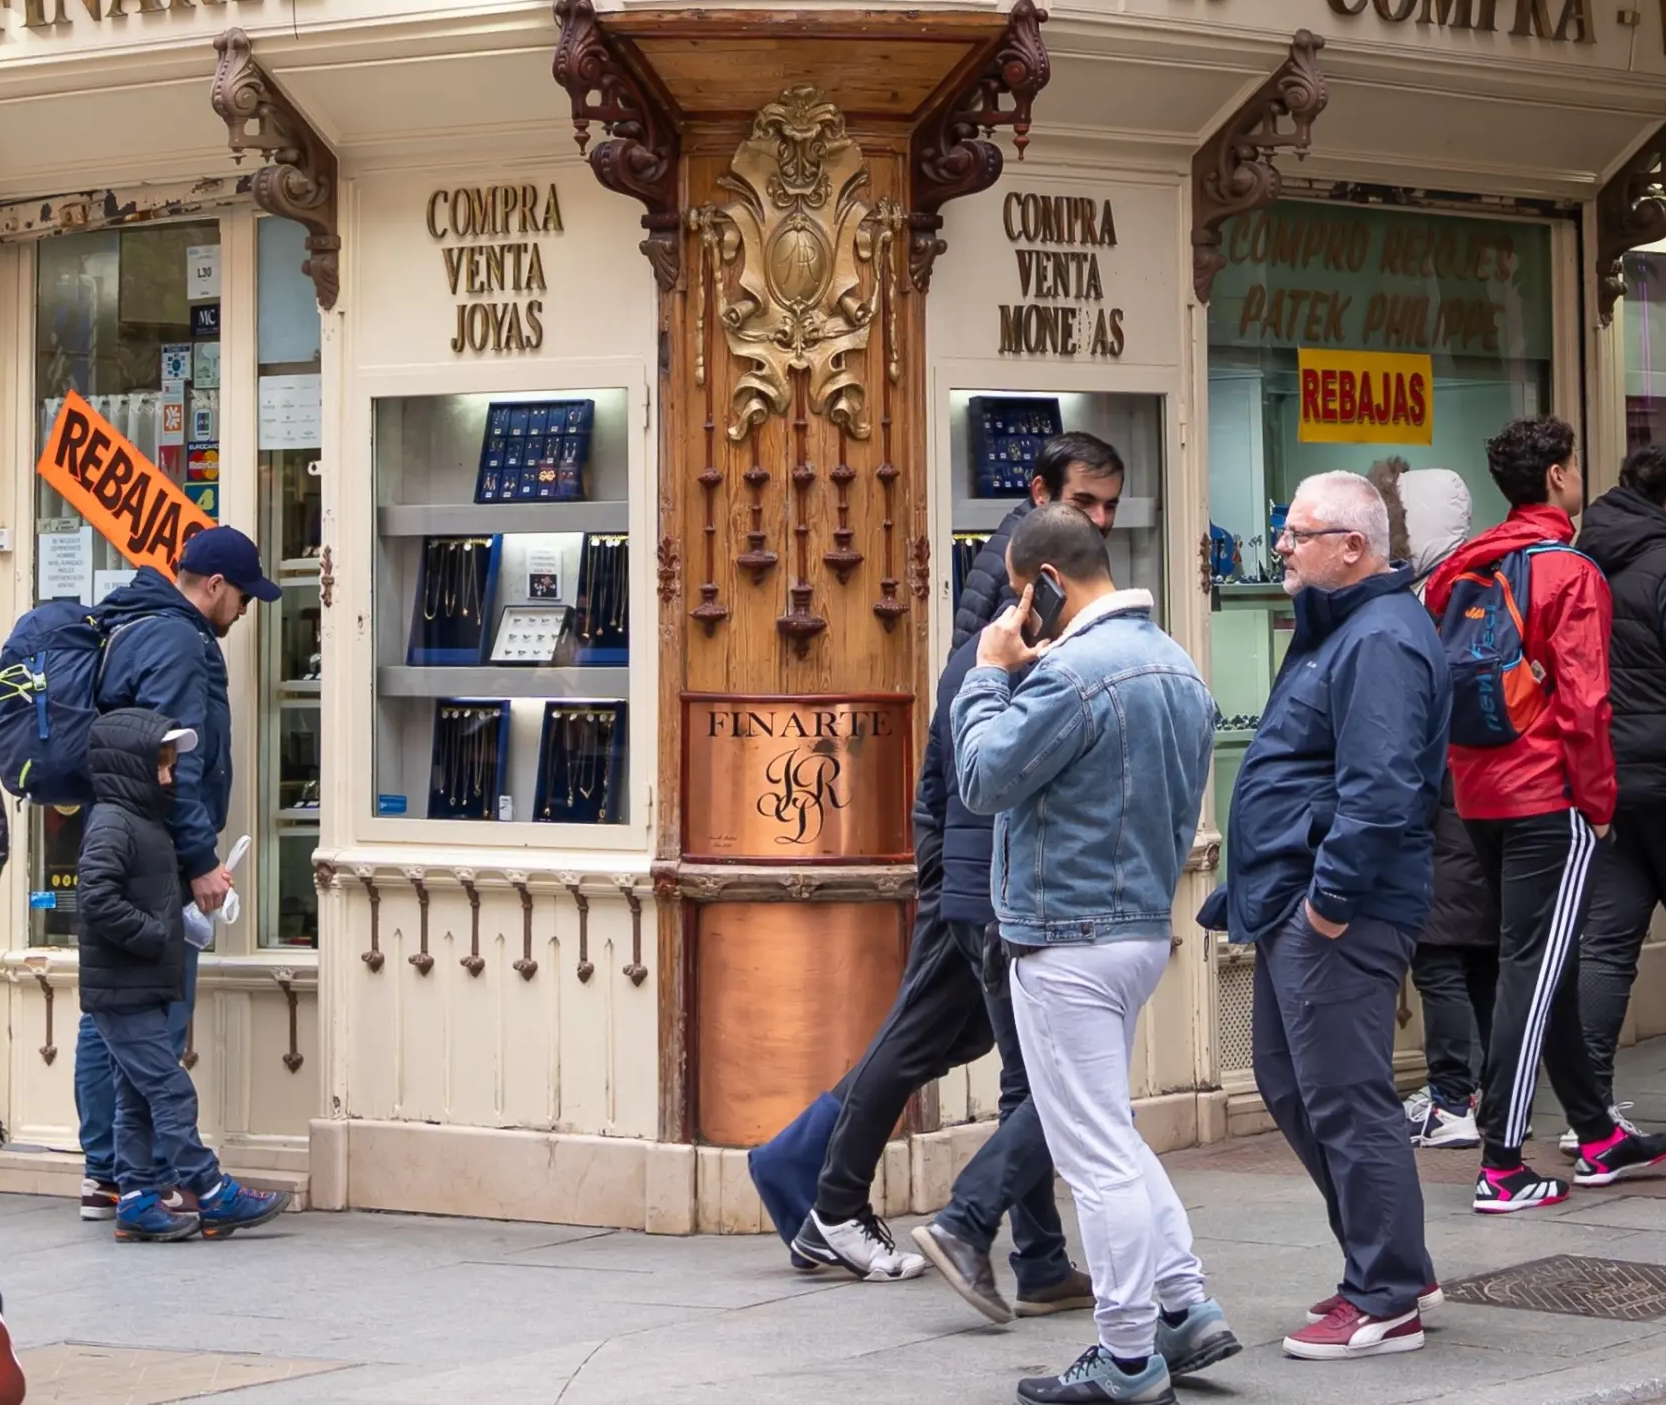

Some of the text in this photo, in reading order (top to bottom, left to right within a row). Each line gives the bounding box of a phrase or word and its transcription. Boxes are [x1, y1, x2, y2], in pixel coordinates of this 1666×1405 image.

[426, 183, 563, 239] COMPRA
[1002, 192, 1117, 247] COMPRA
[441, 243, 547, 296] VENTA
[1229, 205, 1514, 282] COMPRO RELOJES
[1015, 248, 1103, 300] VENTA
[450, 300, 543, 354] JOYAS
[998, 304, 1125, 356] MONEAS
[1239, 284, 1505, 352] PATEK PHILIPPE
[1300, 368, 1427, 428] REBAJAS
[707, 711, 894, 738] FINARTE
